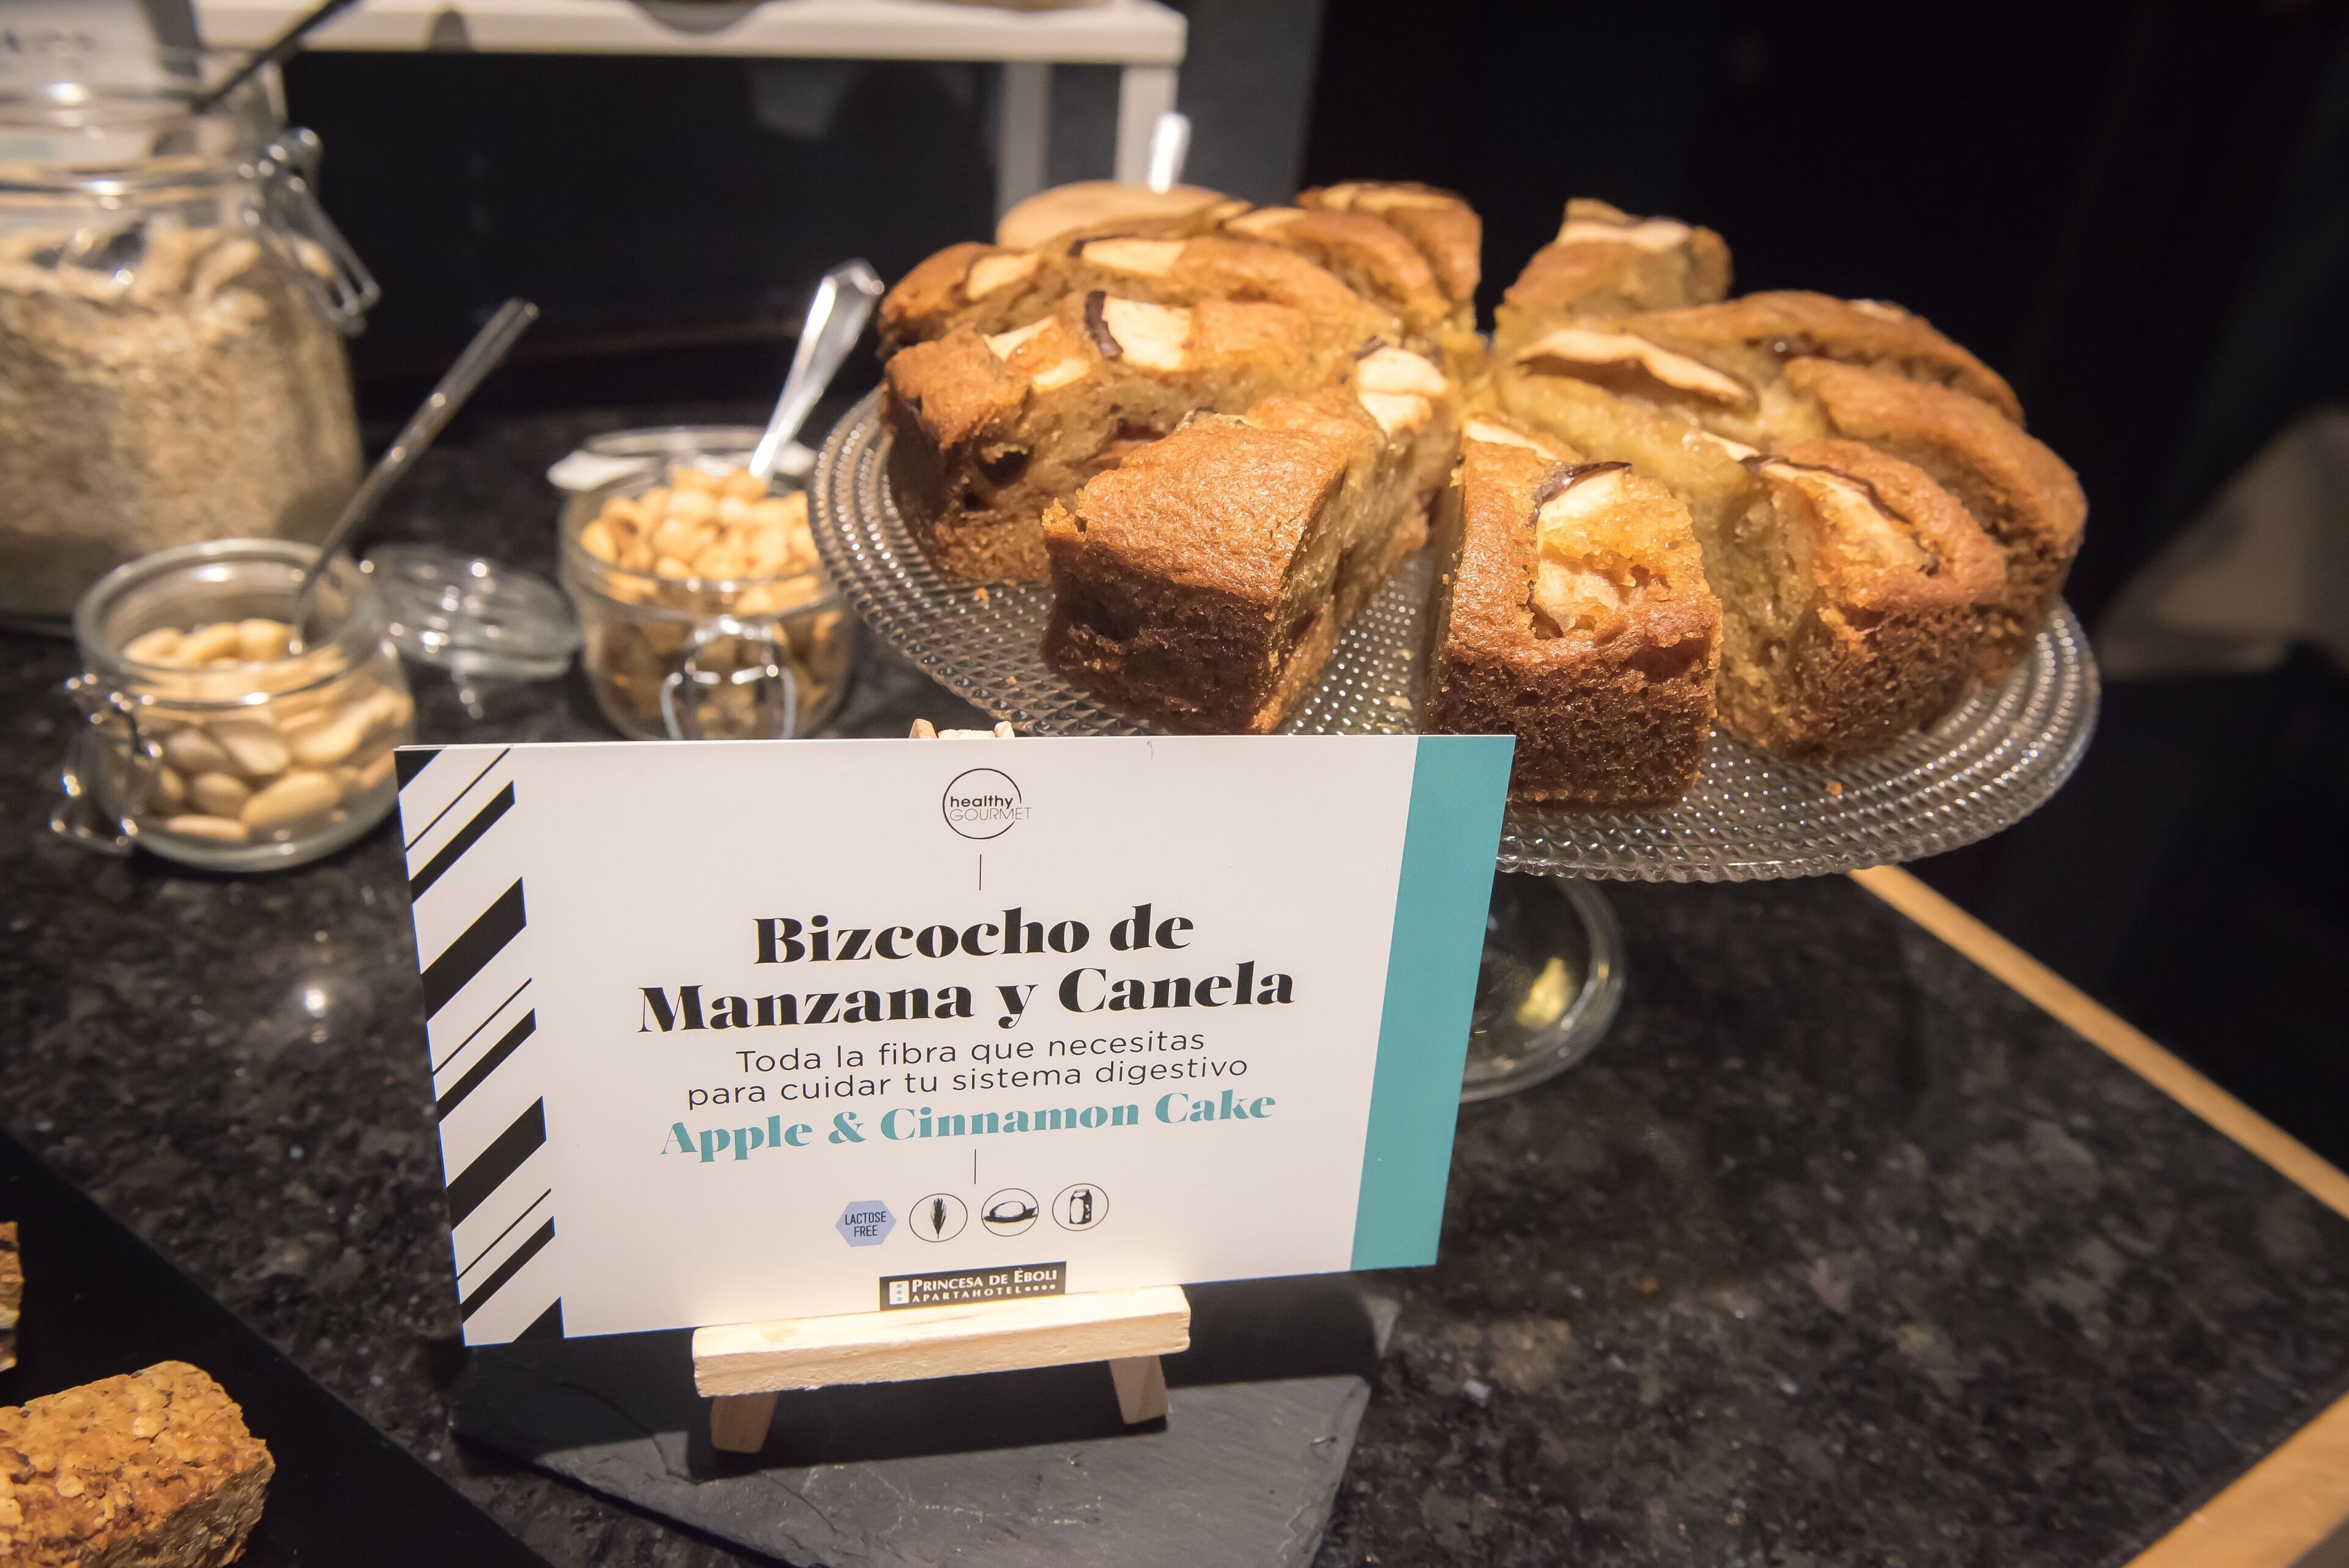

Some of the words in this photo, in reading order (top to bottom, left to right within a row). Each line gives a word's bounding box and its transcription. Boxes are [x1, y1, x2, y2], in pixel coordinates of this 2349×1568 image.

[949, 807, 1033, 822] GOURMET
[950, 795, 1014, 809] healthy
[753, 907, 1089, 964] Bizcocho
[1110, 903, 1194, 951] de
[637, 985, 974, 1033] Manzana
[995, 984, 1038, 1029] y
[1059, 960, 1294, 1013] Canela
[736, 1047, 822, 1073] Toda
[837, 1045, 864, 1068] la
[878, 1042, 956, 1066] fibra
[971, 1042, 1034, 1065] que
[1049, 1030, 1204, 1057] necesitas
[688, 1085, 766, 1111] para
[781, 1074, 892, 1101] cuidar
[904, 1073, 938, 1093] tu
[952, 1068, 1081, 1091] sistema
[1096, 1057, 1248, 1085] digestivo
[661, 1115, 812, 1163] Apple
[828, 1111, 866, 1144] &
[881, 1104, 1138, 1140] Cinnamon
[1156, 1090, 1276, 1124] Cake
[845, 1211, 886, 1225] LACTOSE
[854, 1225, 878, 1237] FREE
[912, 1286, 1022, 1302] APARTAHOTEL
